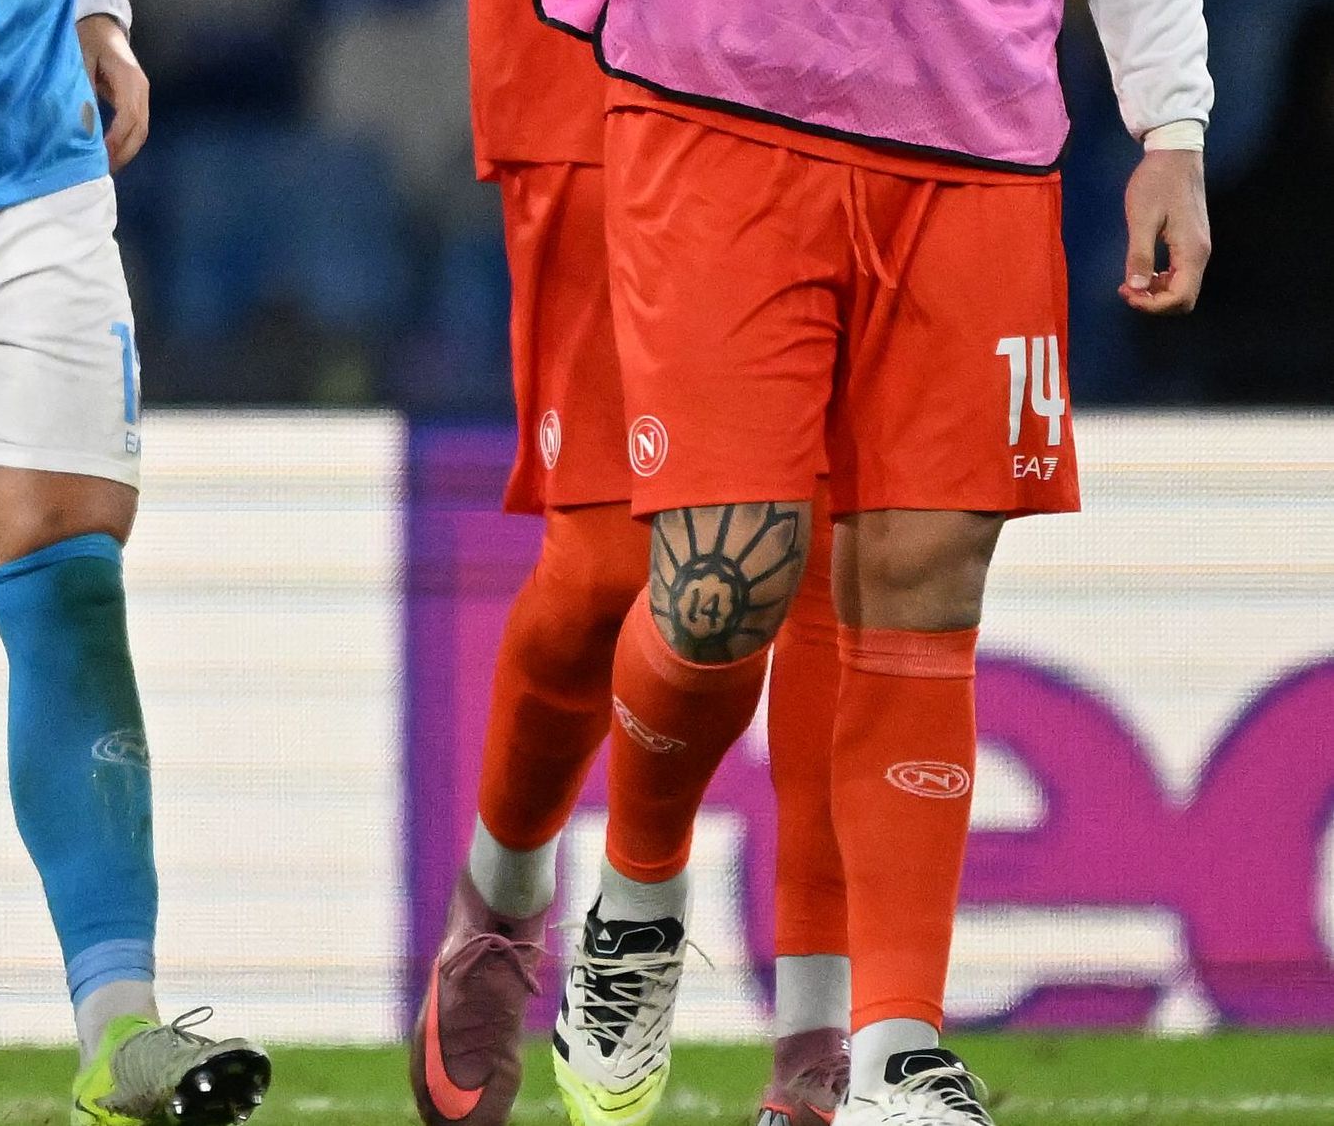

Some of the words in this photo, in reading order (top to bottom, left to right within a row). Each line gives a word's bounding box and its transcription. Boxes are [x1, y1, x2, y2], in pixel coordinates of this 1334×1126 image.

[995, 335, 1066, 447] 14
[637, 430, 658, 462] N
[1013, 454, 1059, 481] EA7
[688, 587, 721, 629] 14
